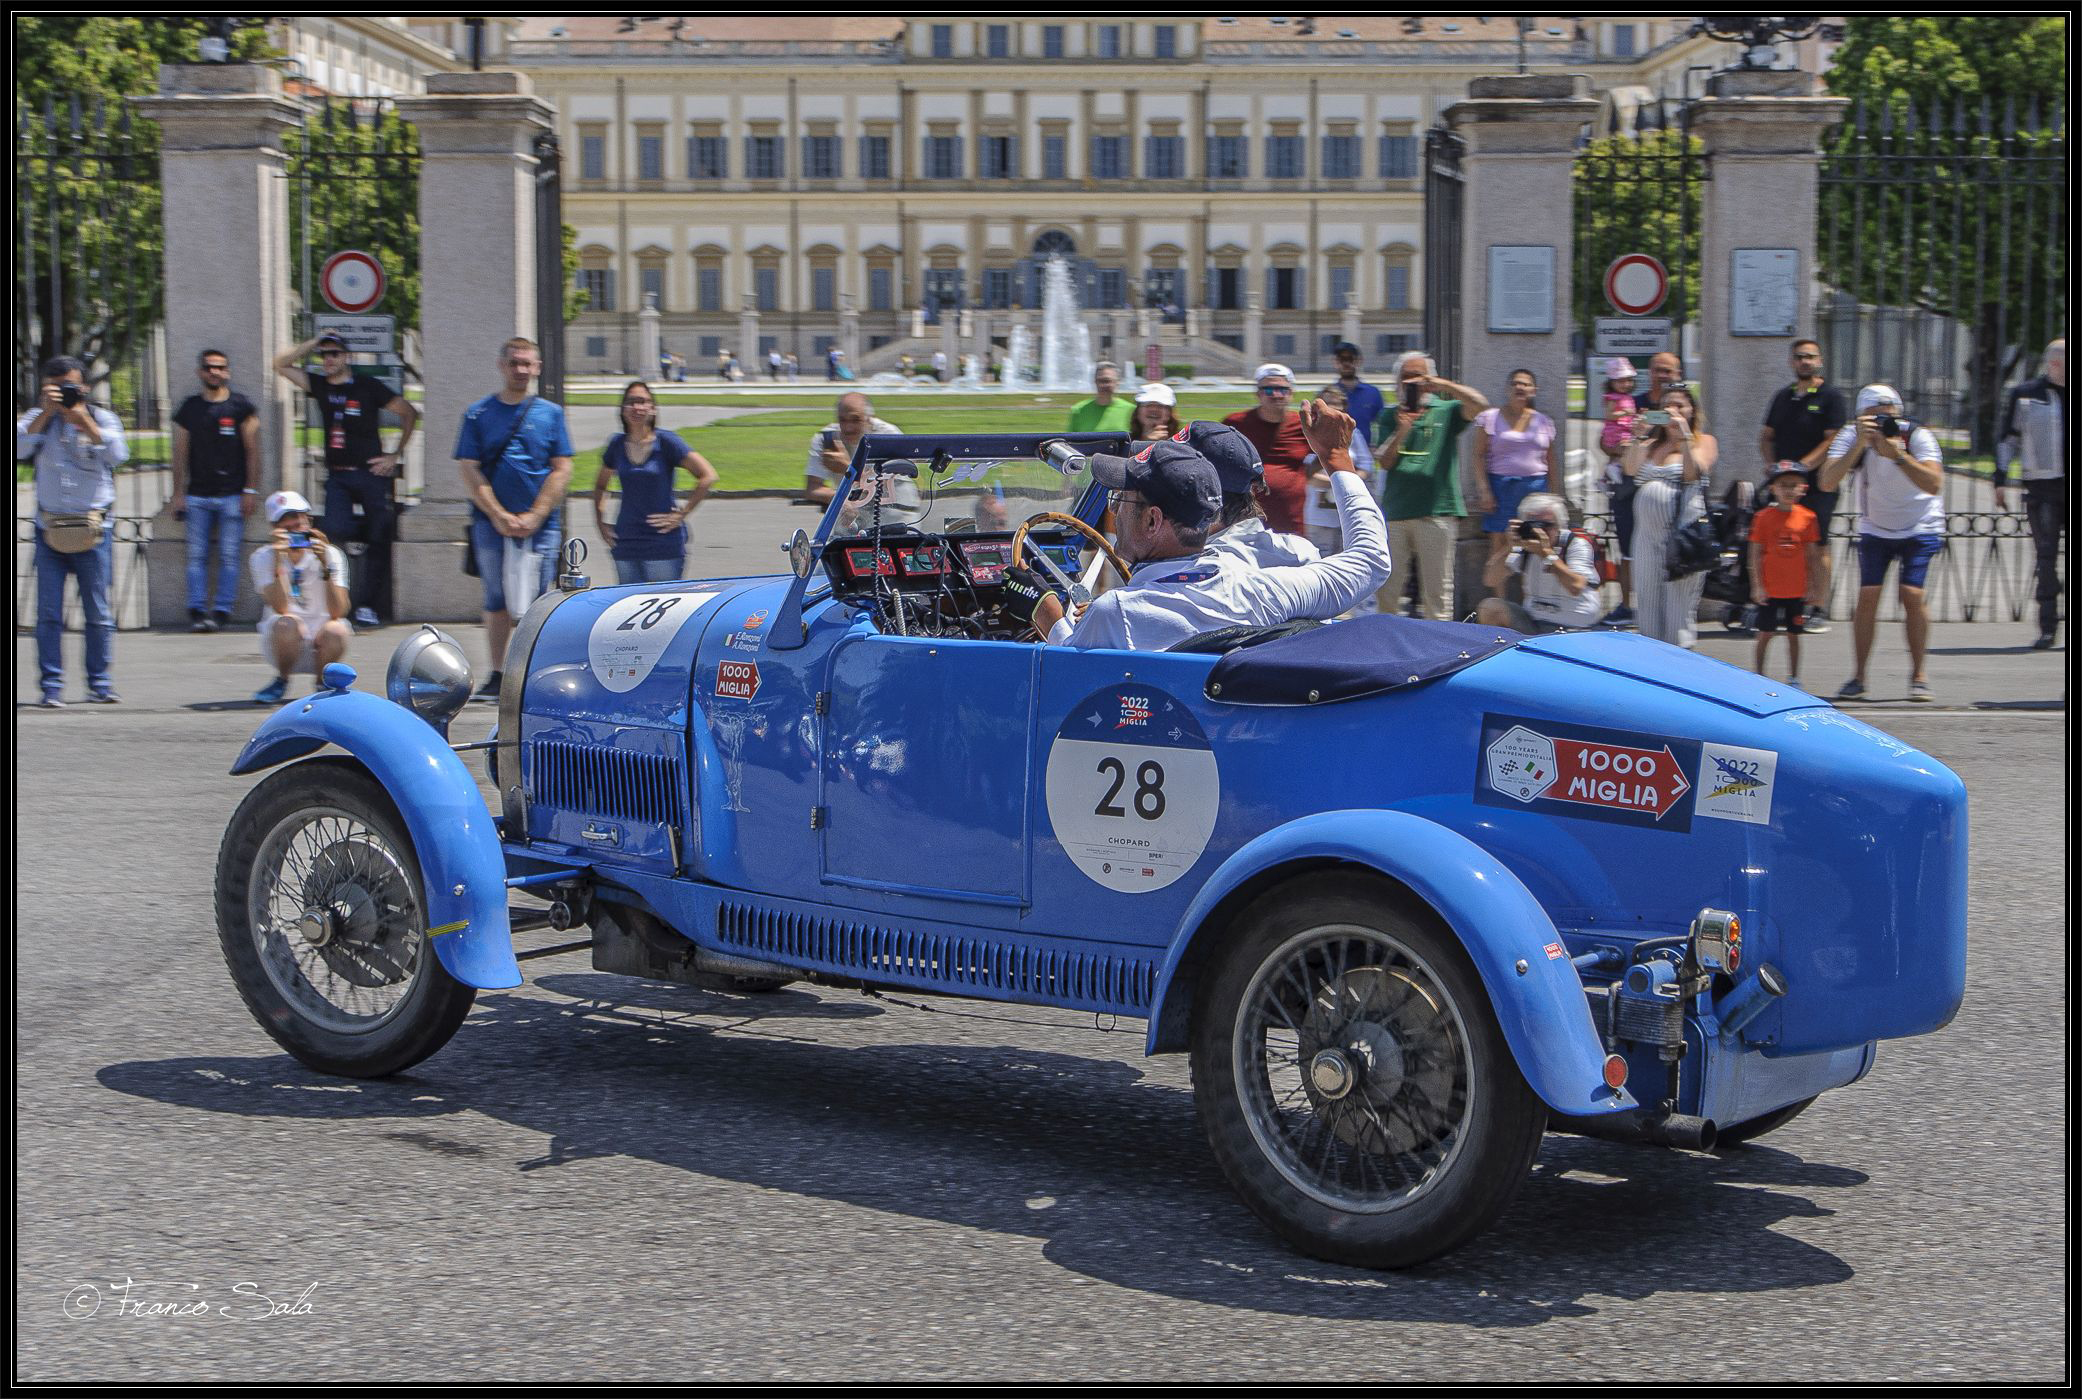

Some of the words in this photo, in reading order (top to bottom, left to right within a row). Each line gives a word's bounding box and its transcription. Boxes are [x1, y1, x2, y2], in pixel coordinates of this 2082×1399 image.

[616, 597, 682, 631] 28
[722, 664, 751, 679] 1000
[718, 680, 751, 696] MIGLIA
[1120, 696, 1149, 710] 2022
[1119, 718, 1148, 727] MIGLIA
[1507, 751, 1529, 759] PREMIO
[1577, 747, 1657, 778] 1000
[1716, 757, 1760, 776] 2022
[1094, 756, 1166, 821] 28
[1567, 776, 1659, 808] MIGLIA
[1713, 784, 1757, 798] MIGLIA
[1108, 836, 1151, 848] CHOPARD
